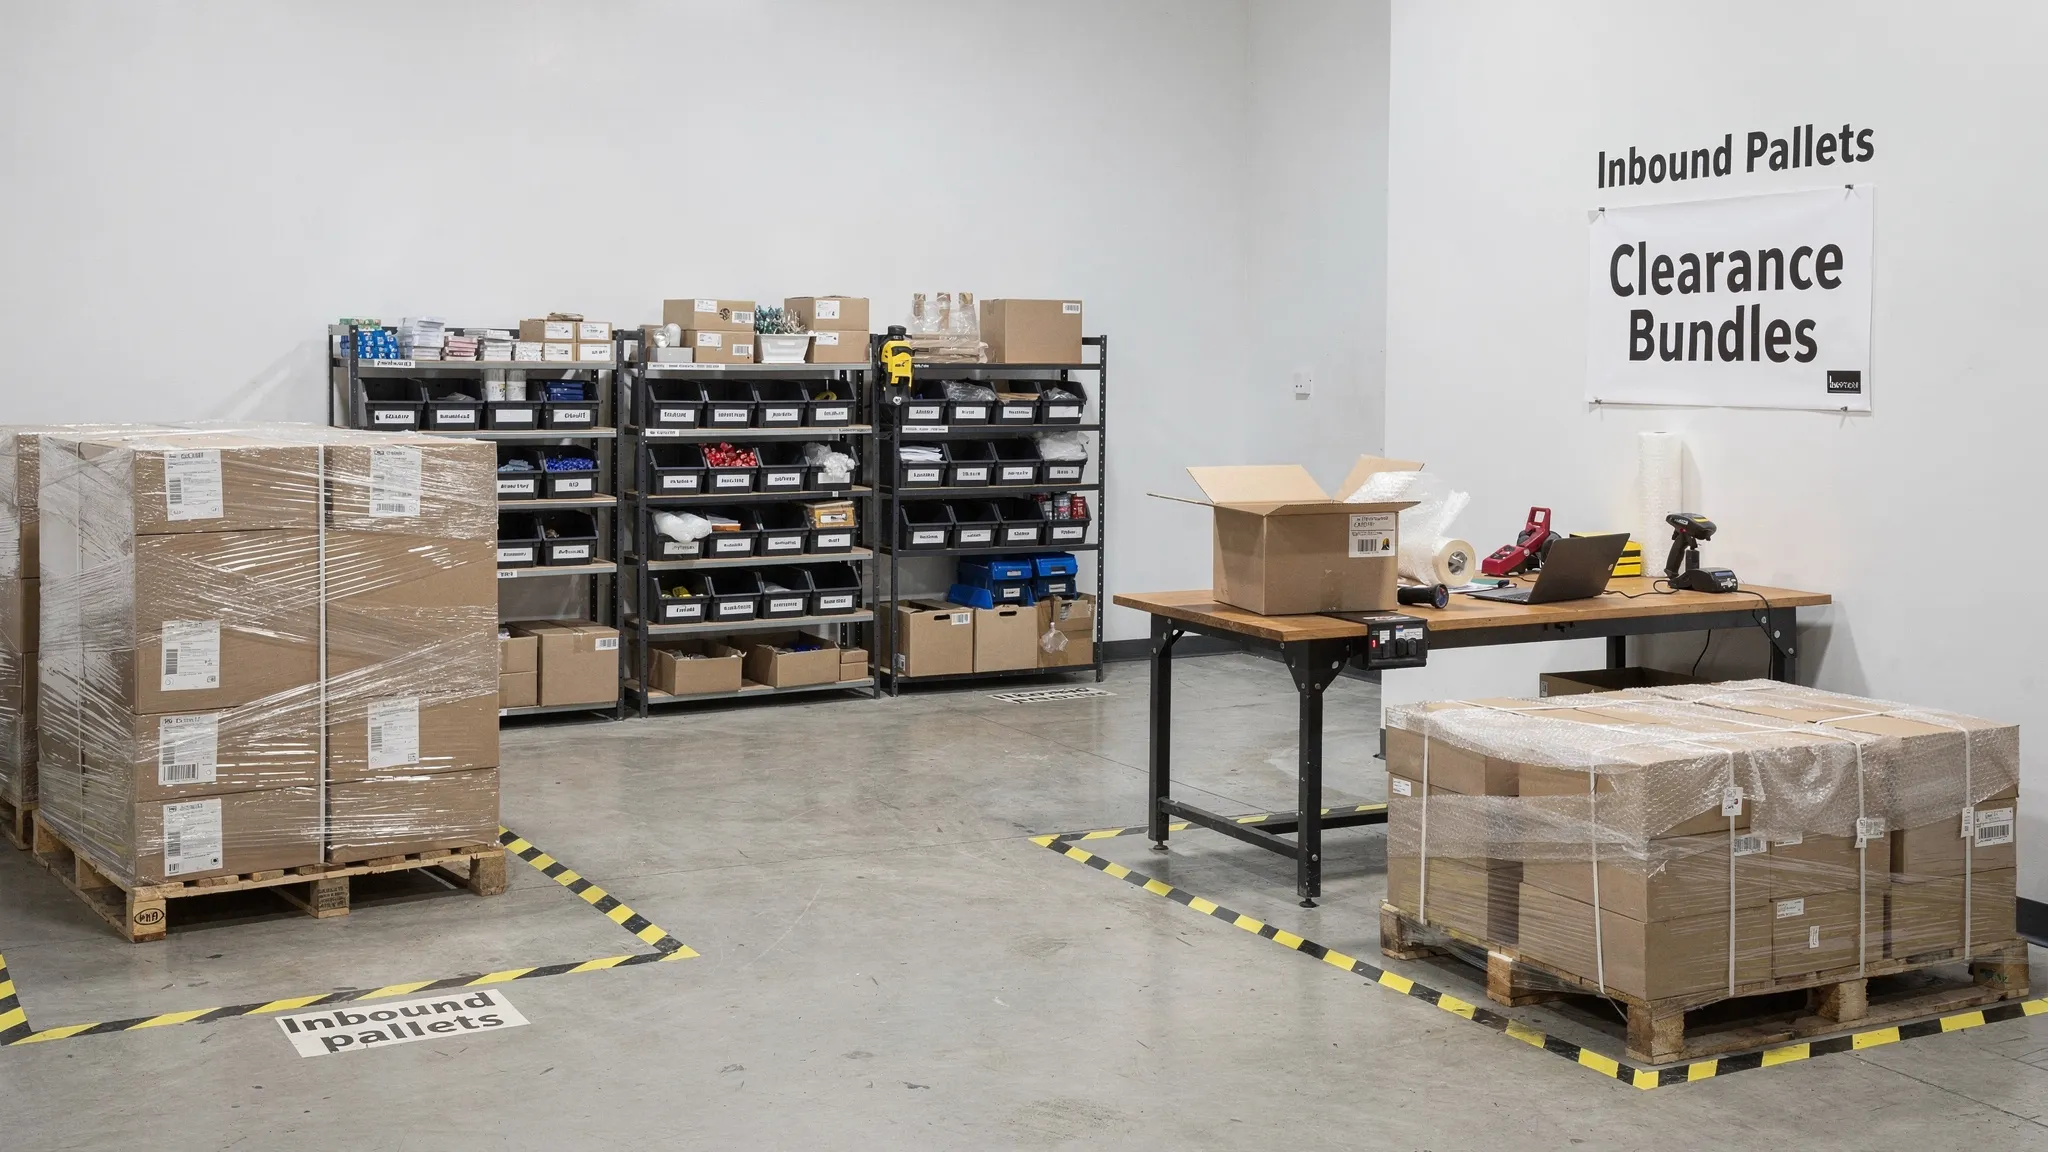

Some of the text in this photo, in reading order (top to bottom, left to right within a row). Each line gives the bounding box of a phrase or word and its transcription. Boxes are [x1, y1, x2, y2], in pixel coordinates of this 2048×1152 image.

[1599, 124, 1875, 188] Inbound Pallets
[1610, 241, 1844, 297] Clearance
[1630, 304, 1818, 363] Bundles
[282, 992, 496, 1034] Inbound
[320, 1014, 504, 1053] pallets
